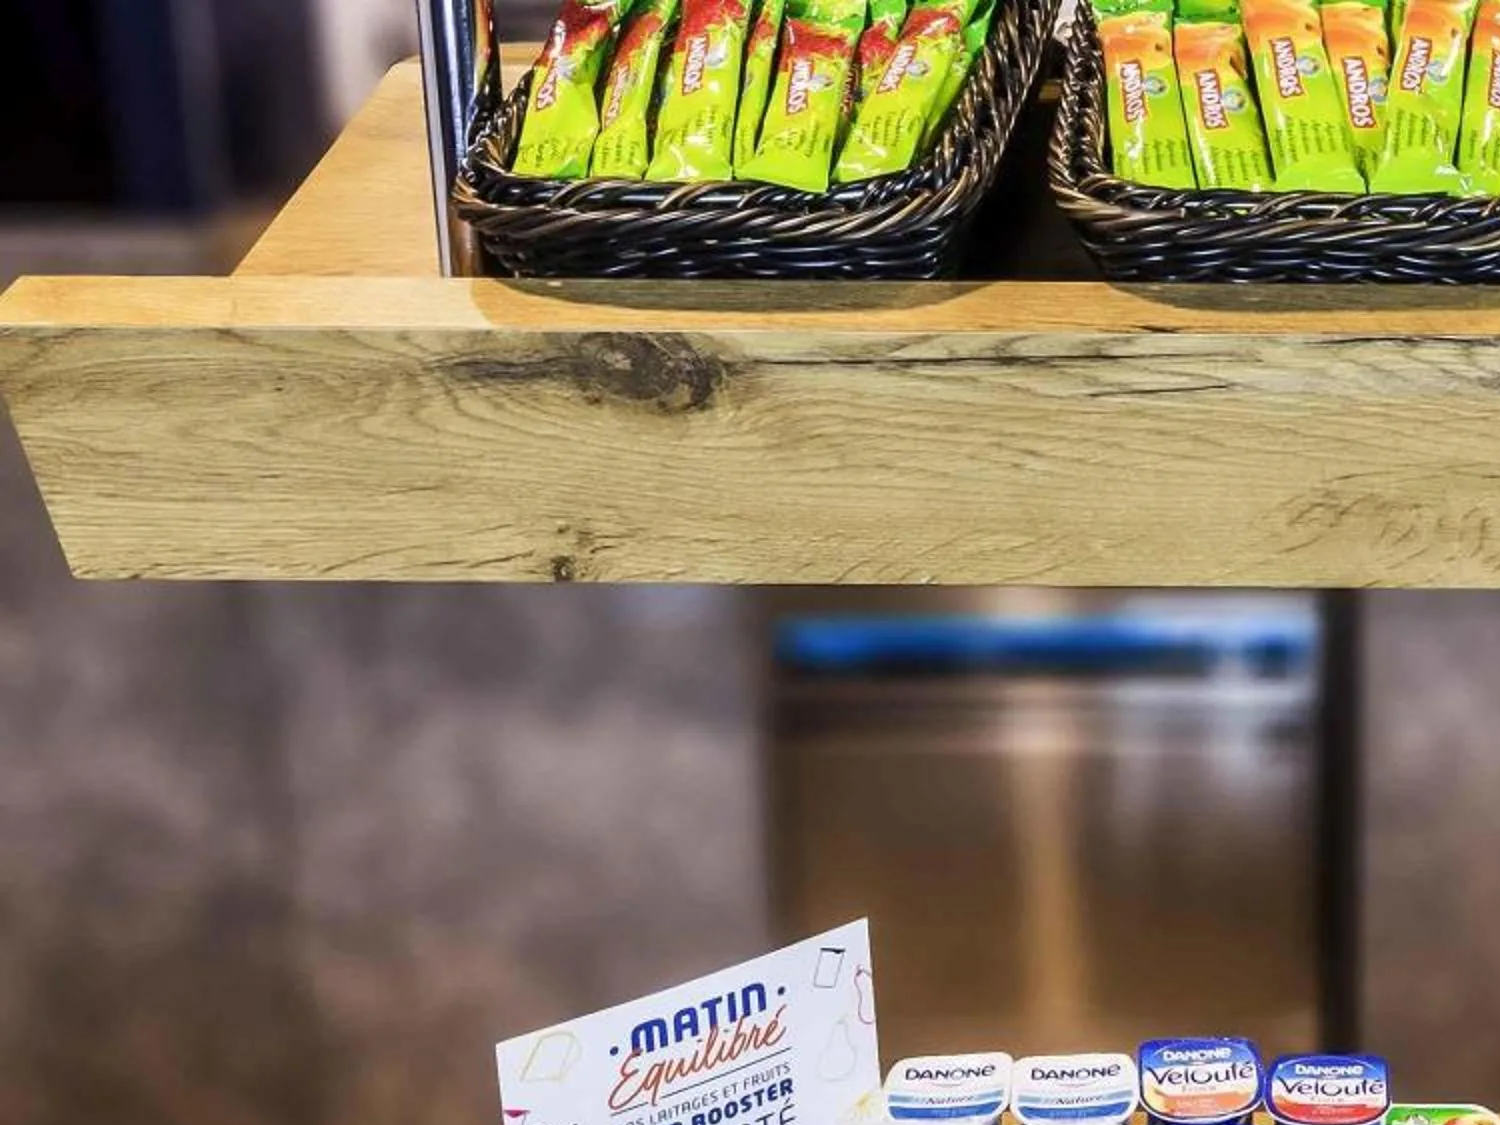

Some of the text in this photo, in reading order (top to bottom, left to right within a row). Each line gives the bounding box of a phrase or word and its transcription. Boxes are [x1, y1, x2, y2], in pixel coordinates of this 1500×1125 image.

[1344, 58, 1375, 127] ANDROS
[1164, 1048, 1232, 1062] DANONE
[905, 1062, 998, 1081] DANONE
[1030, 1062, 1121, 1082] DANONE
[1148, 1062, 1254, 1085] Velouté
[1295, 1064, 1365, 1076] DANONE
[722, 1083, 740, 1101] ET
[742, 1063, 792, 1095] FRUITS
[1278, 1075, 1385, 1097] Velouté
